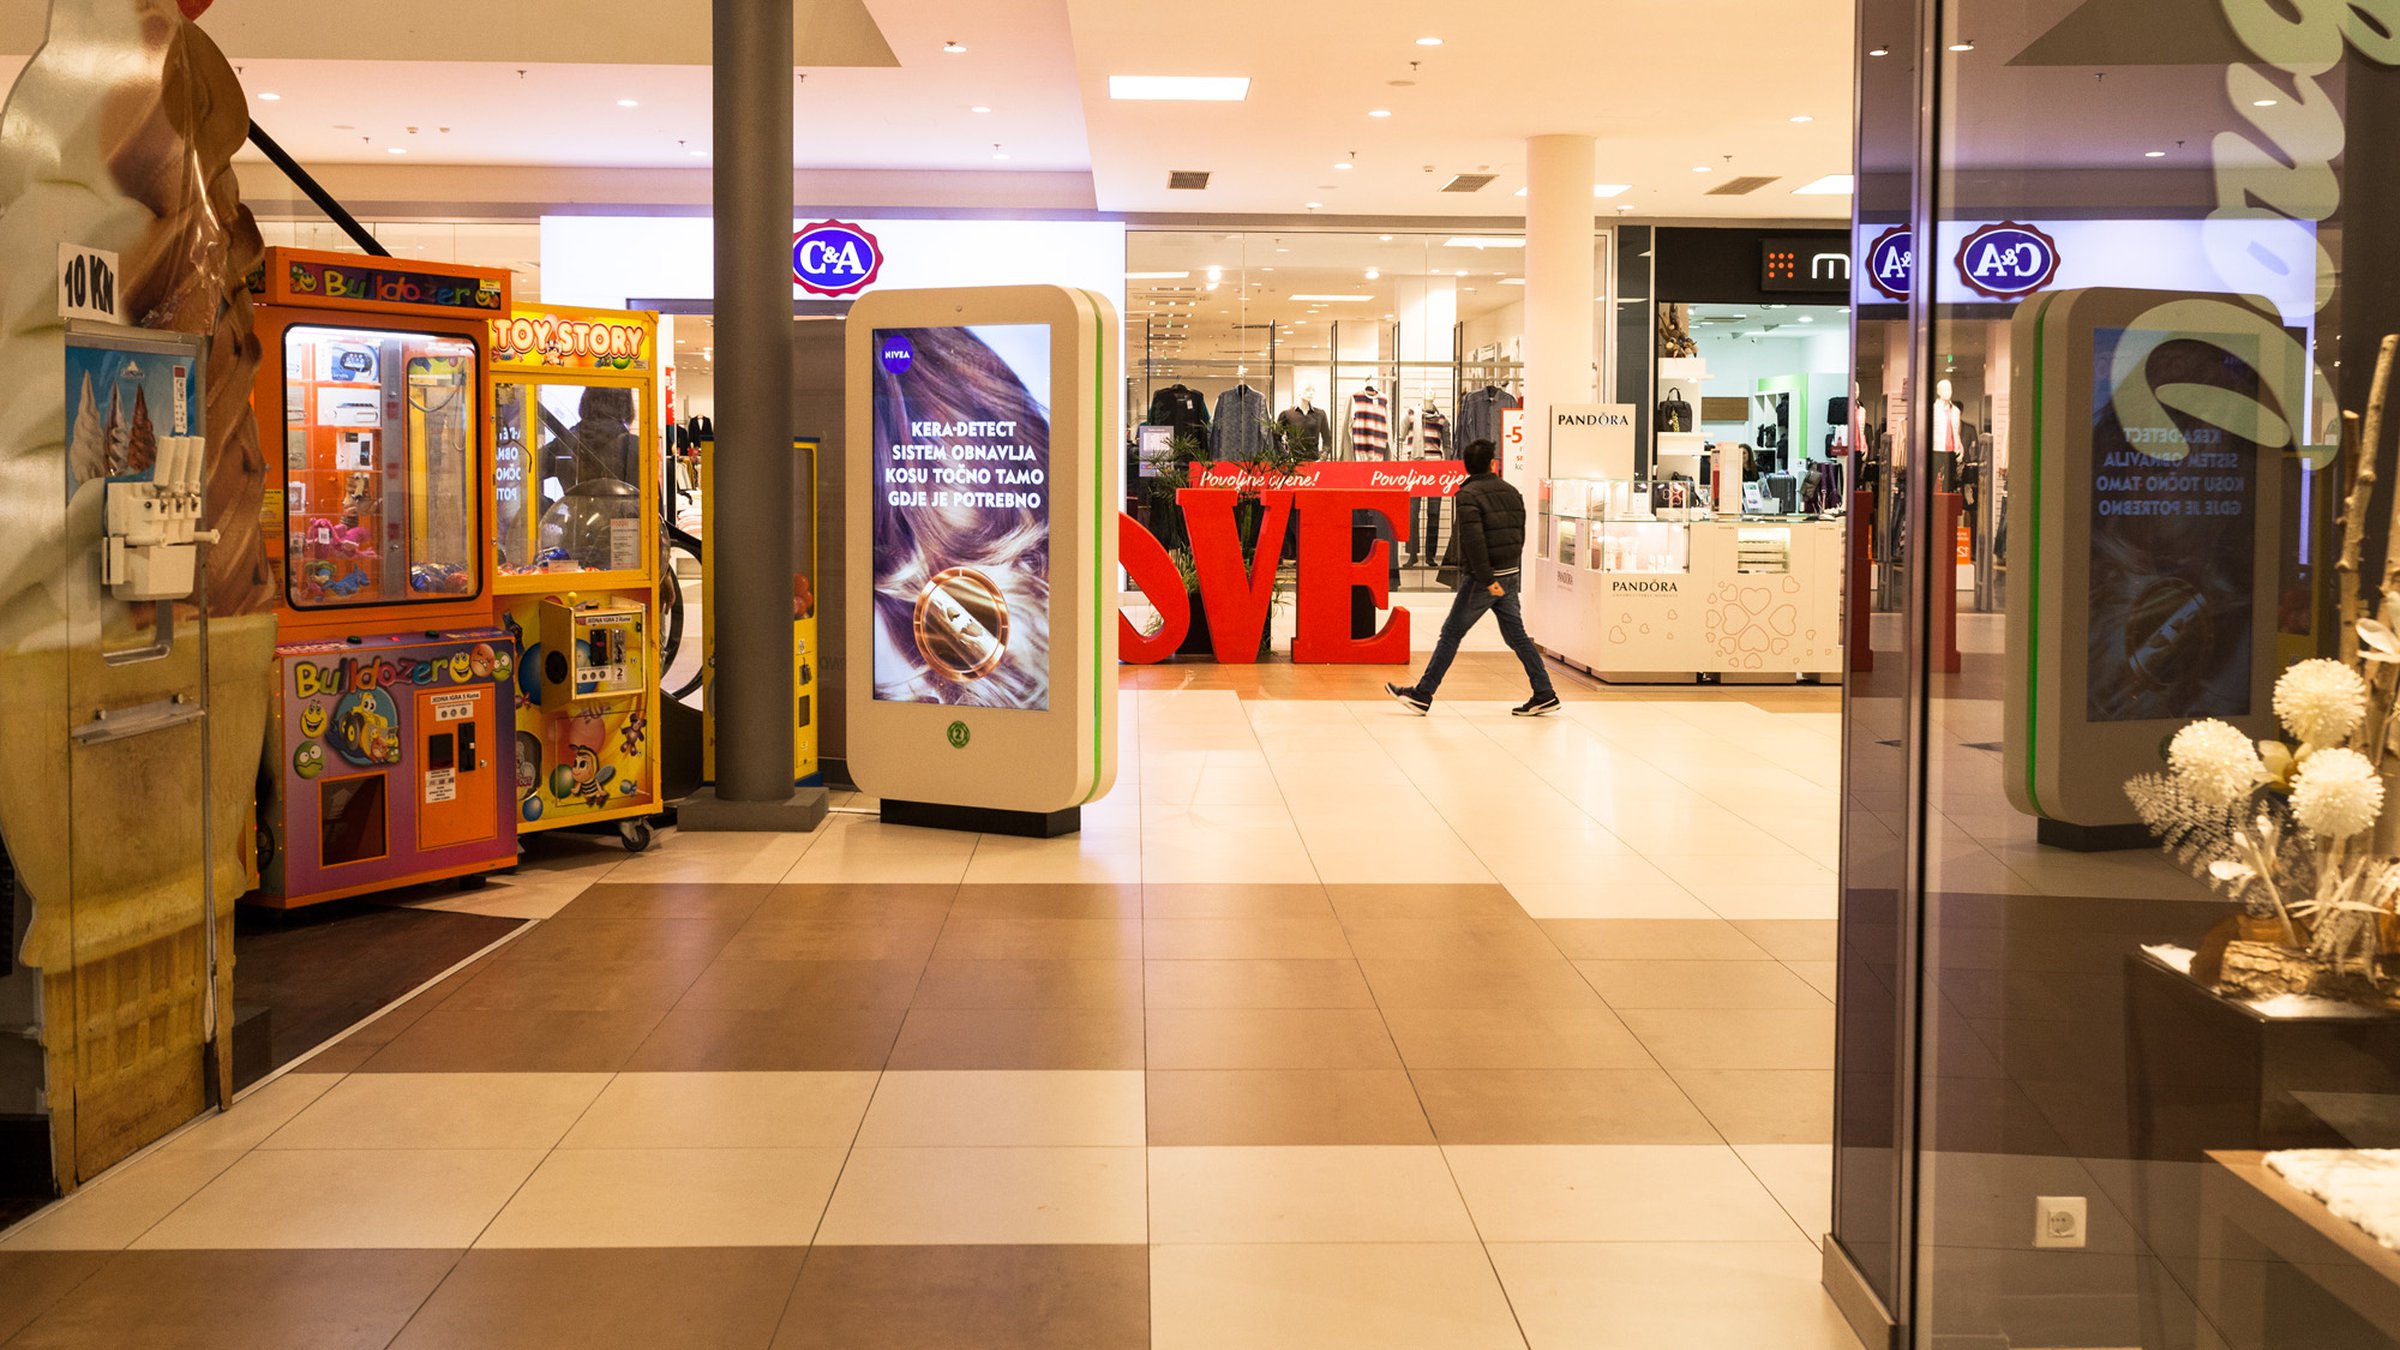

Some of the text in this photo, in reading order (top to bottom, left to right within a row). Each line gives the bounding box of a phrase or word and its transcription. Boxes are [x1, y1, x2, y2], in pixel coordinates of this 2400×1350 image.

[800, 240, 866, 274] C&A
[64, 254, 114, 315] 10 KN
[323, 269, 472, 305] Bulldozer
[492, 318, 645, 359] TOY STORY
[884, 351, 910, 359] NIVEA
[911, 421, 1017, 437] KERA-DETECT
[1558, 412, 1629, 426] PANDORA
[892, 445, 1037, 461] SISTEM OBNAVLJA
[885, 463, 1044, 485] KOSU TOČNO TAMO
[1200, 469, 1321, 491] Povoljne cijene!
[1371, 469, 1436, 491] Povoljne
[888, 491, 1041, 508] GDJE JE POTREBNO
[1612, 579, 1678, 592] PANDORA
[295, 656, 450, 698] Bulldozer
